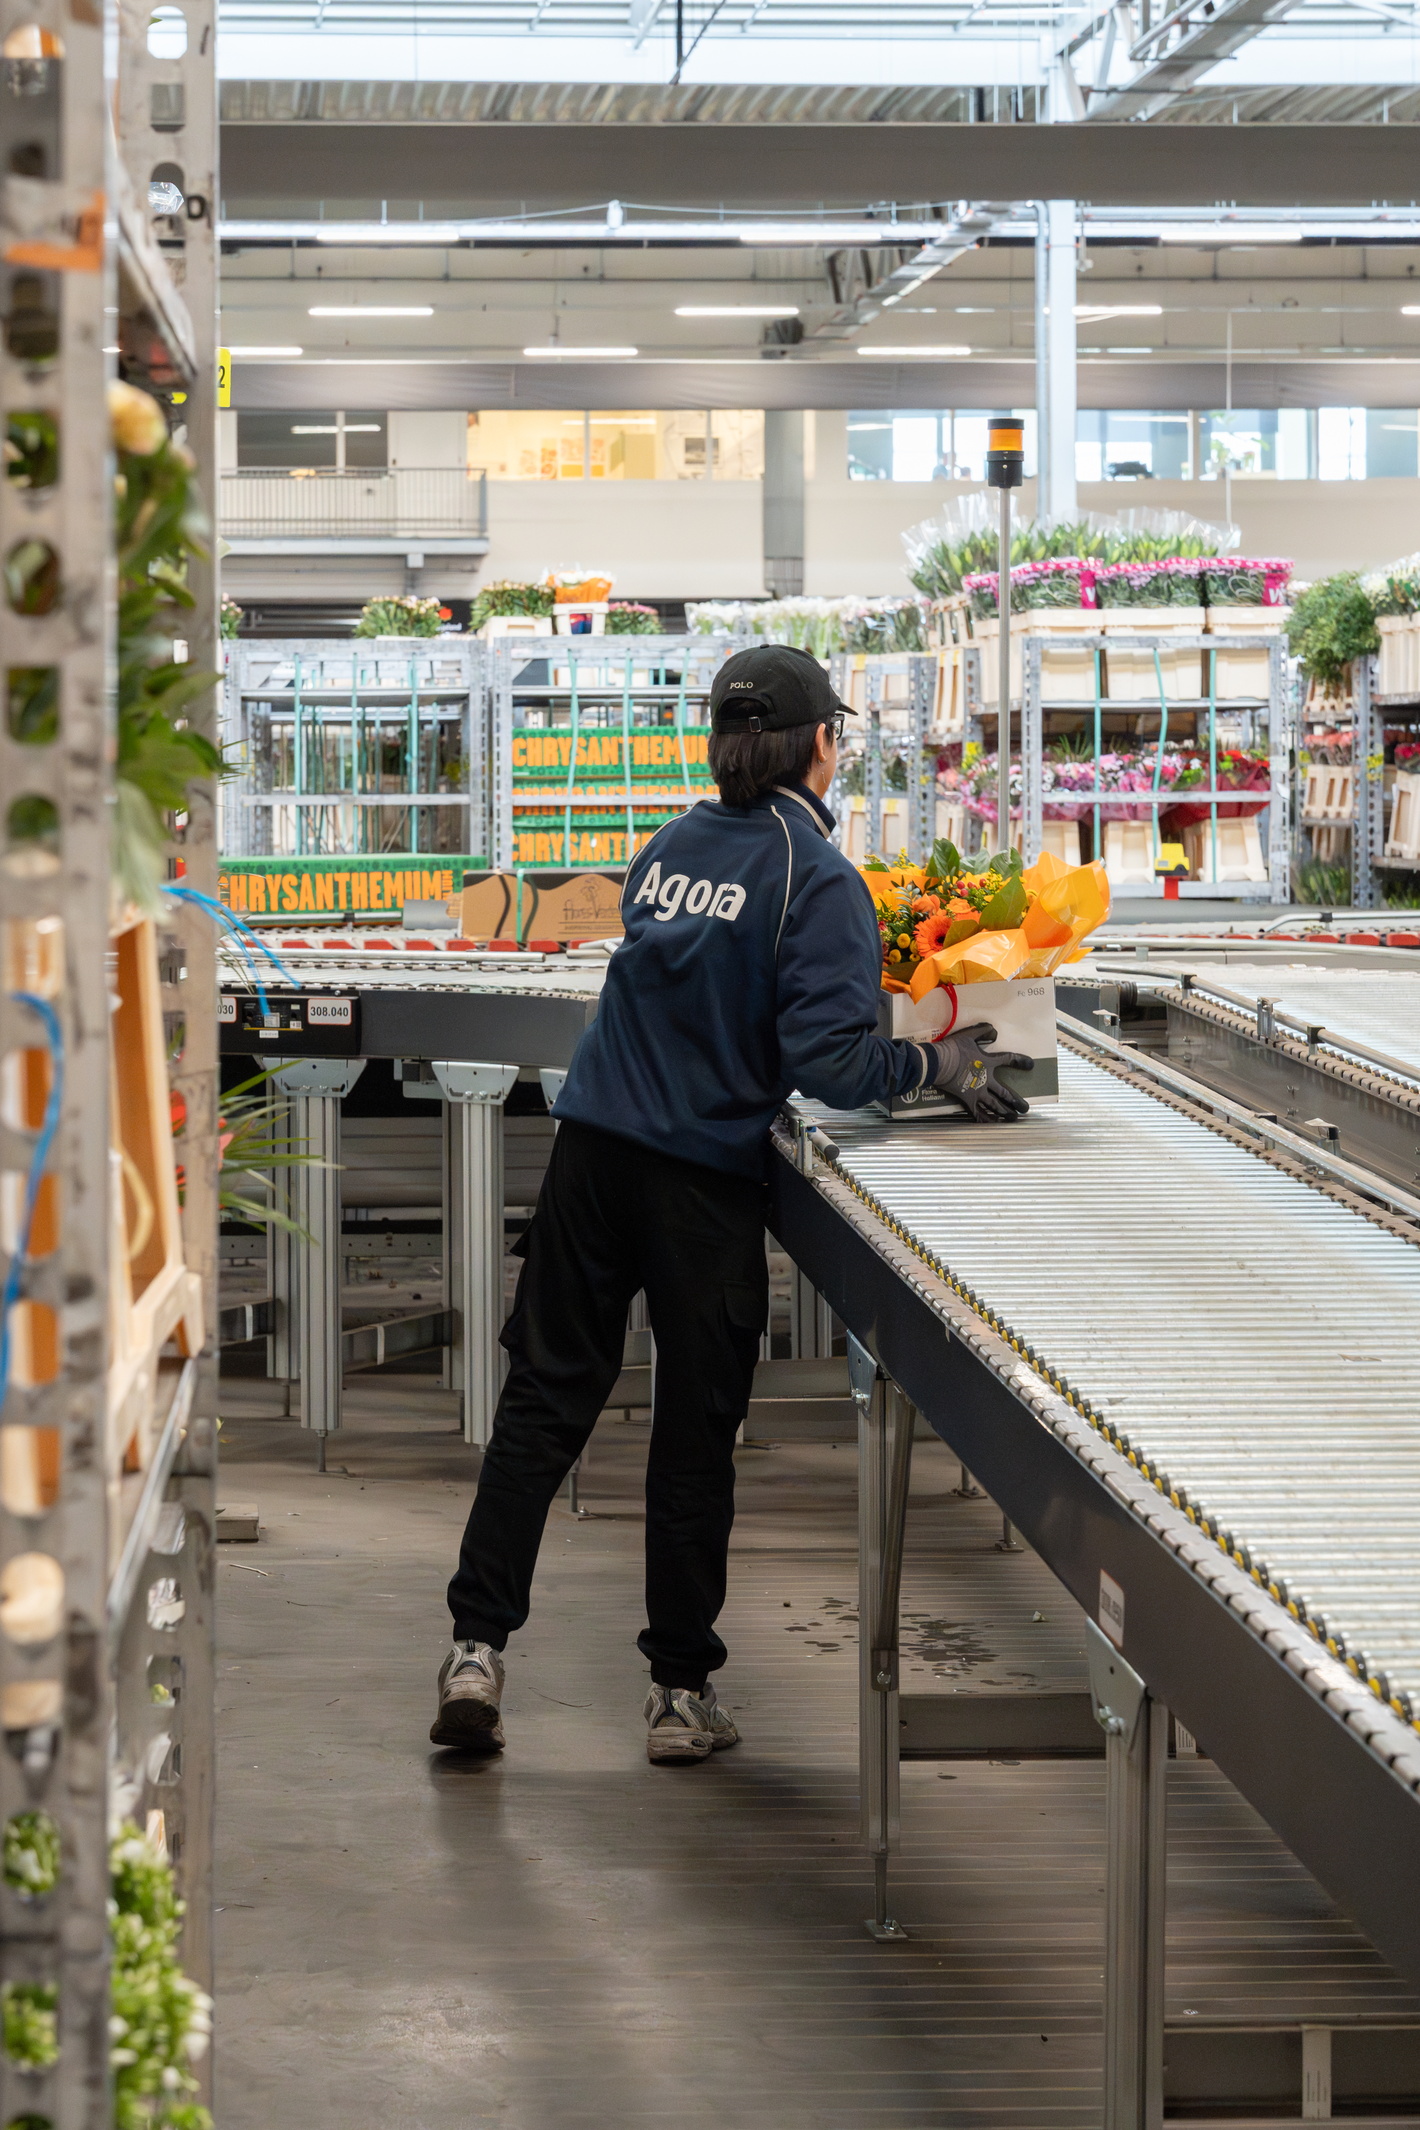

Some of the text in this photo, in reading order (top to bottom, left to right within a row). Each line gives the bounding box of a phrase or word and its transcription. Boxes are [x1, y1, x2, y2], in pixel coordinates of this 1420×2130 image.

[729, 681, 754, 690] POLO
[633, 861, 747, 922] Agora
[1027, 986, 1045, 997] 968
[310, 1006, 349, 1018] 308.040
